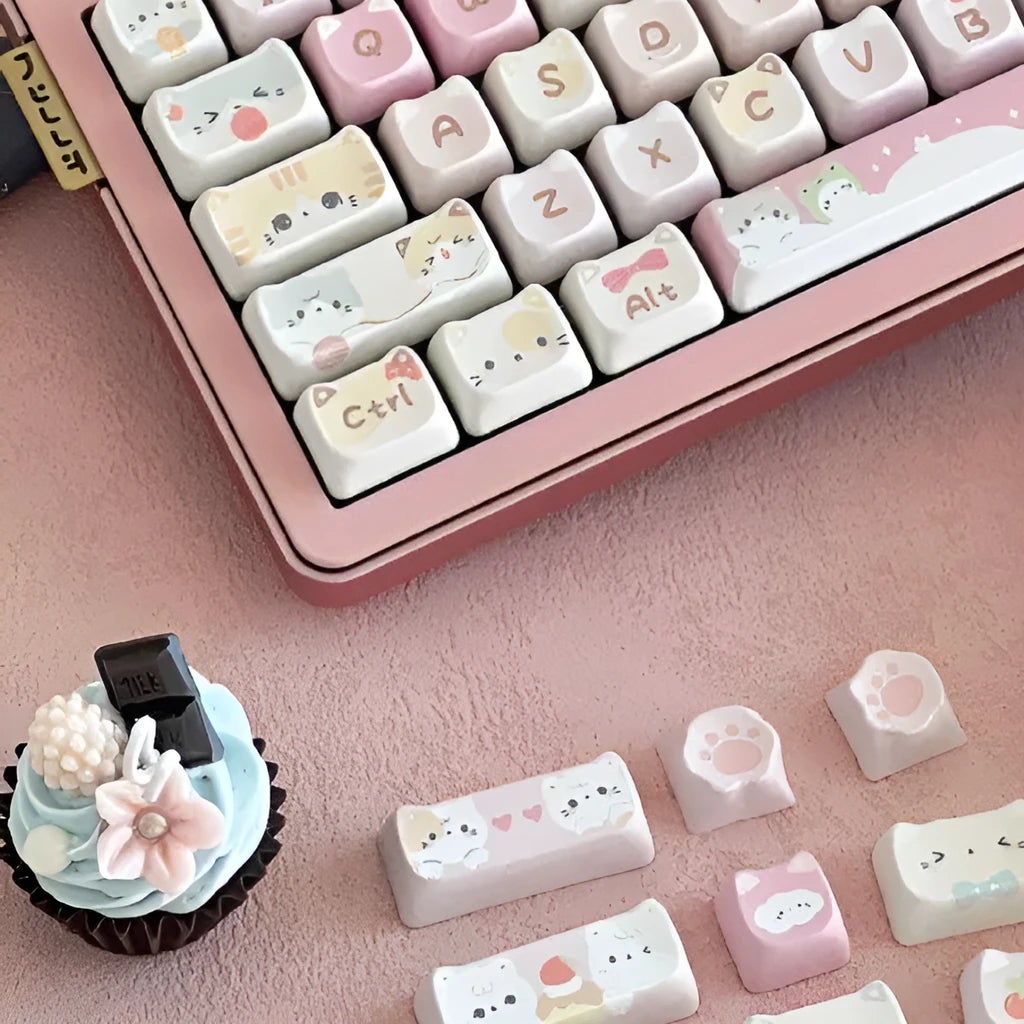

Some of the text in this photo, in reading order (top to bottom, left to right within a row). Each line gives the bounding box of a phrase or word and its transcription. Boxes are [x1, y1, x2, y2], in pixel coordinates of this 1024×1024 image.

[638, 20, 671, 52] D
[953, 8, 990, 43] B
[352, 28, 383, 58] Q
[842, 40, 873, 74] V
[536, 62, 566, 98] S
[744, 89, 774, 122] C
[431, 114, 464, 149] A
[637, 137, 672, 170] X
[532, 188, 569, 219] Z
[625, 282, 679, 321] Alt
[342, 382, 414, 430] Ctrl
